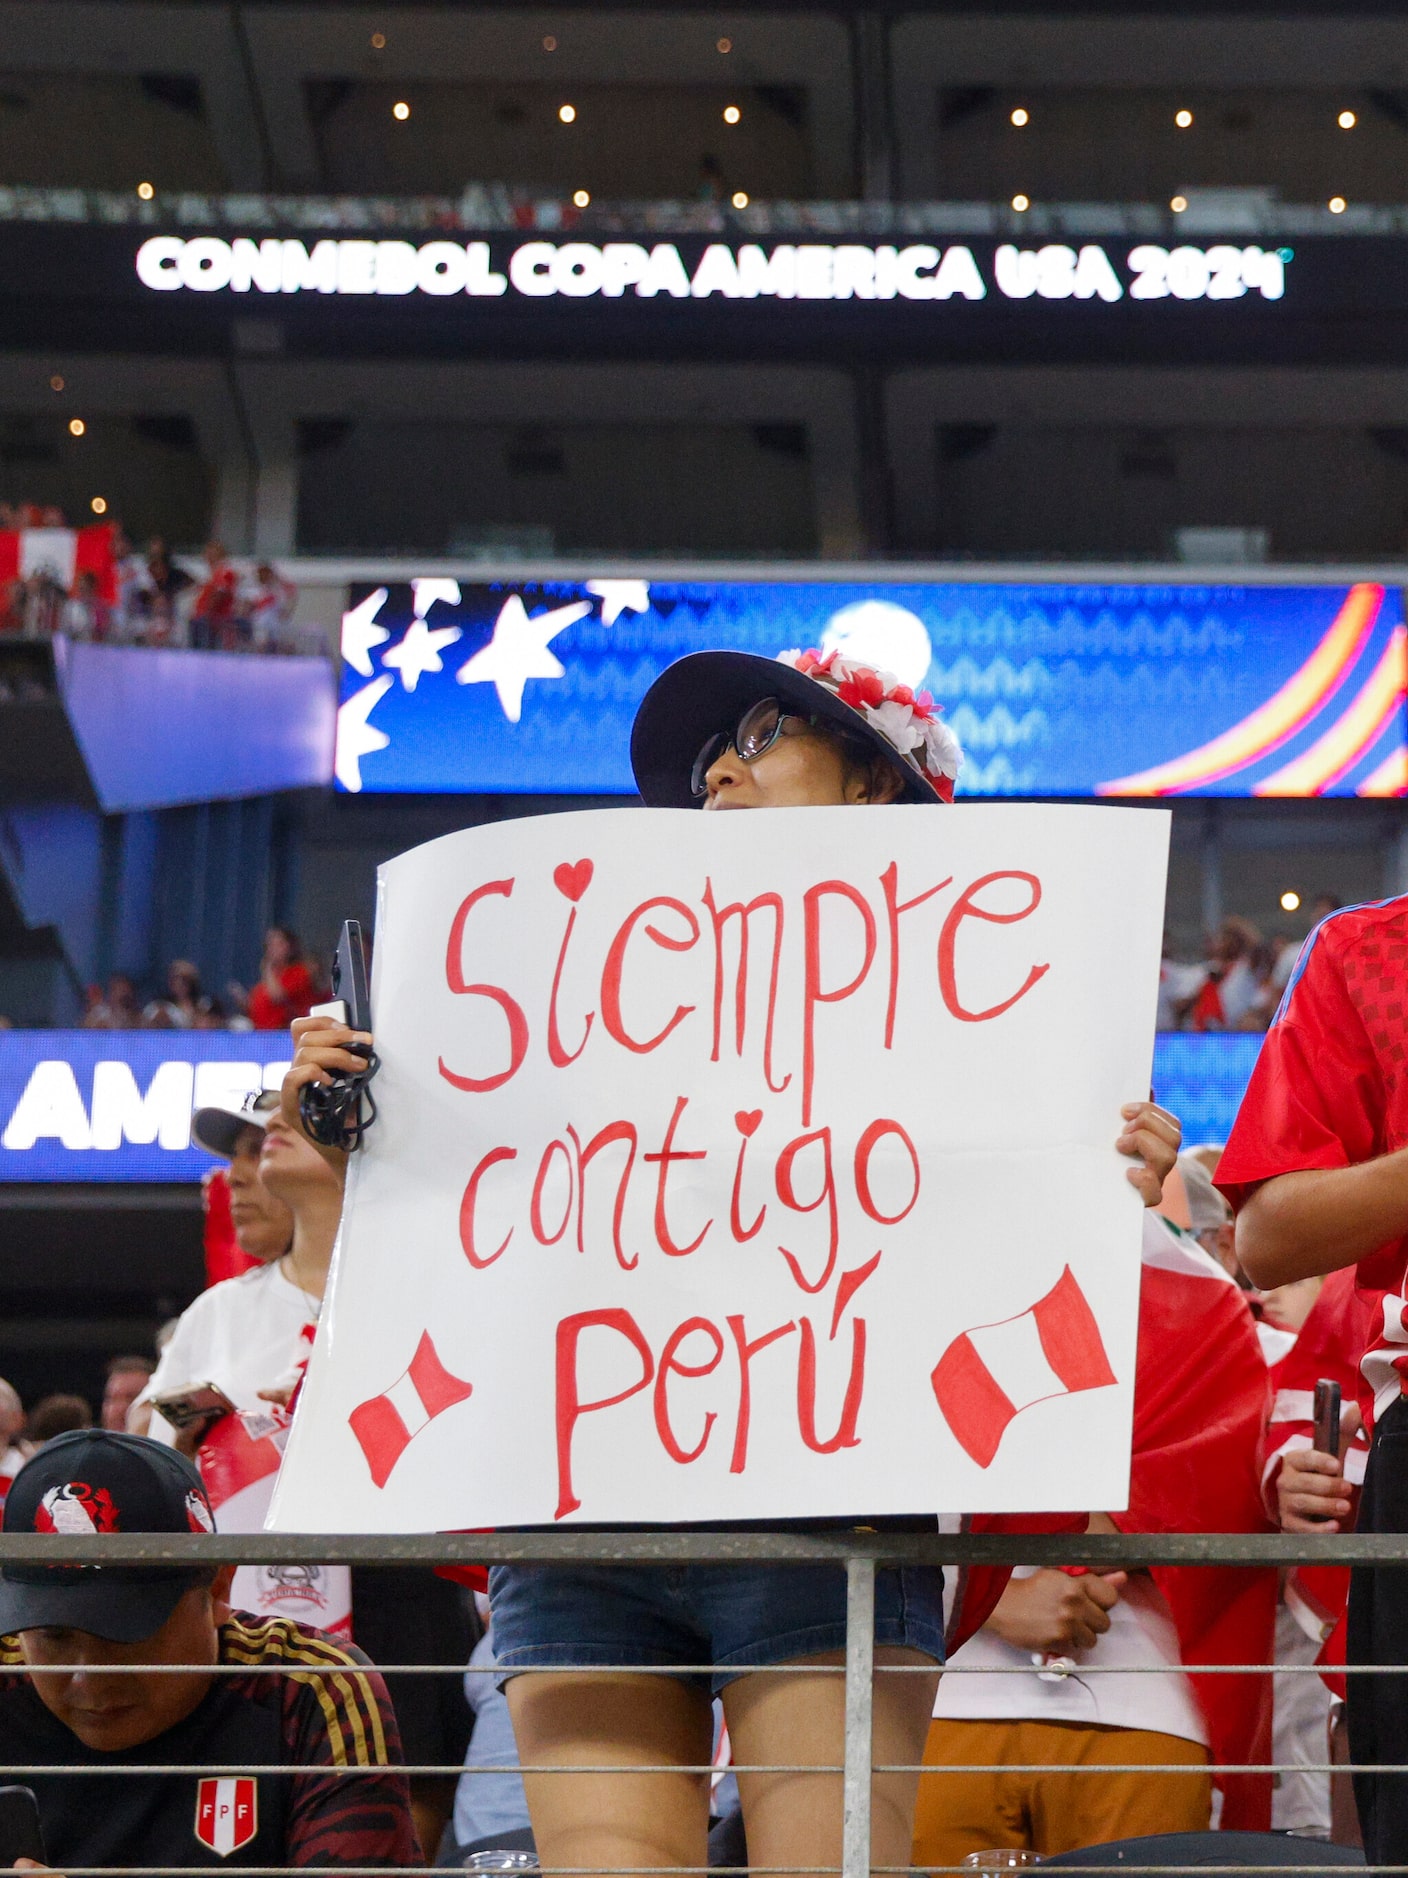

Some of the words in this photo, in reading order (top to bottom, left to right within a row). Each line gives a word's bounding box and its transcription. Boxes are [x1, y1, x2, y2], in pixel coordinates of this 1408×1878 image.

[136, 236, 507, 296] CONMEBOL
[509, 242, 691, 298] COPA
[690, 244, 986, 300] AMERICA
[995, 244, 1123, 302] USA
[1128, 245, 1292, 300] 2024
[460, 1096, 920, 1294] contigo
